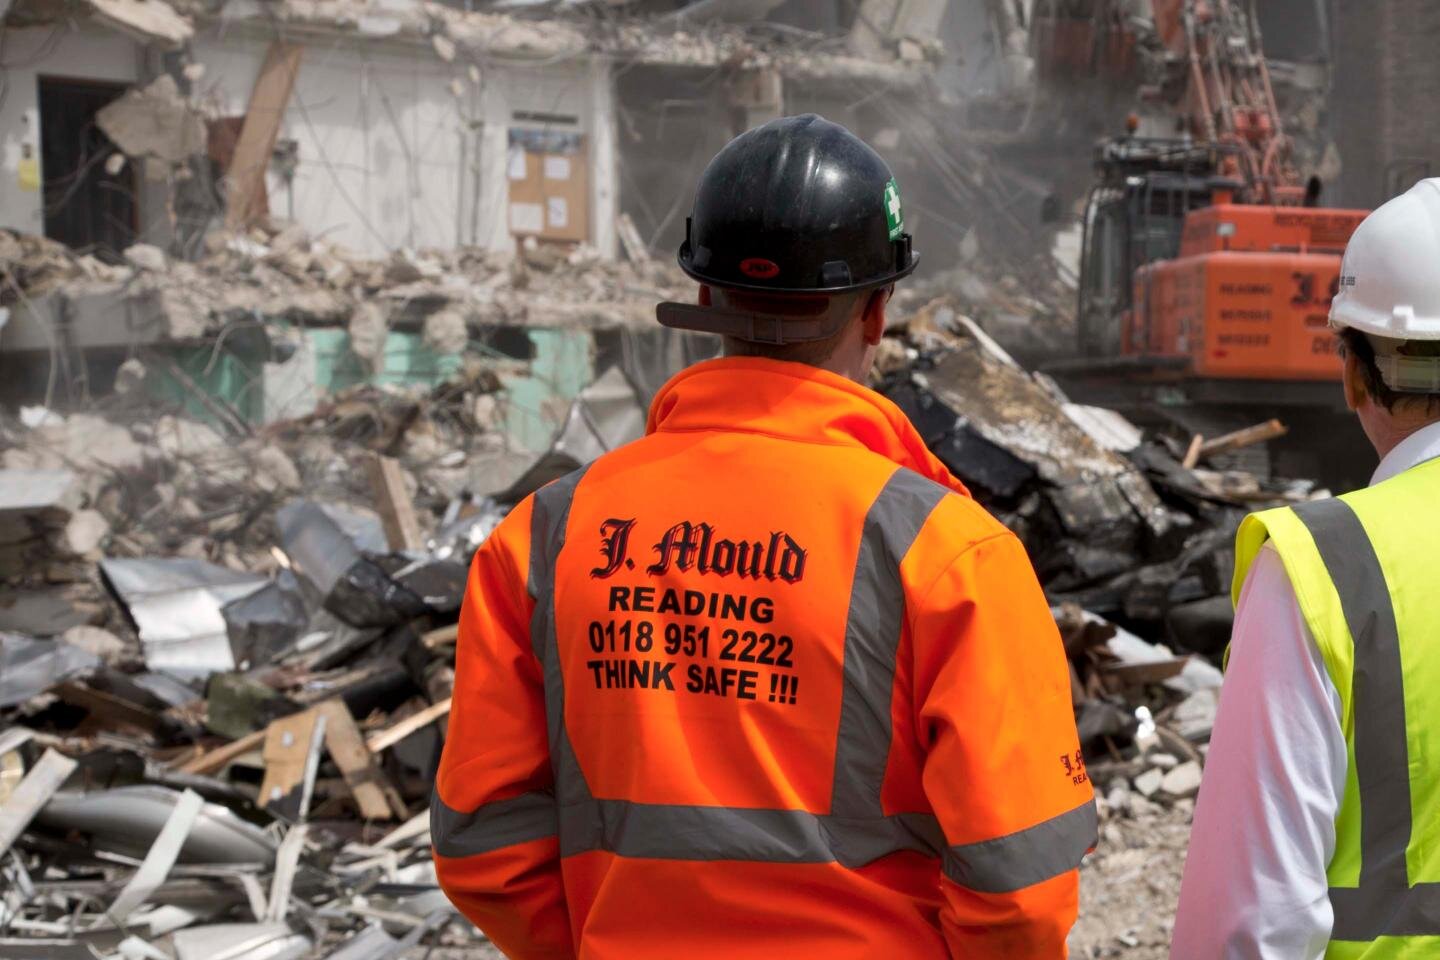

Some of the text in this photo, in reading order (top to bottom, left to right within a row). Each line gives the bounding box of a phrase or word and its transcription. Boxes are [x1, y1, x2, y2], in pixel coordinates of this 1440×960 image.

[589, 518, 808, 585] J. Mould
[608, 586, 774, 623] READING
[588, 620, 794, 667] 0118 951 2222
[587, 659, 799, 705] THINK SAFE !!!
